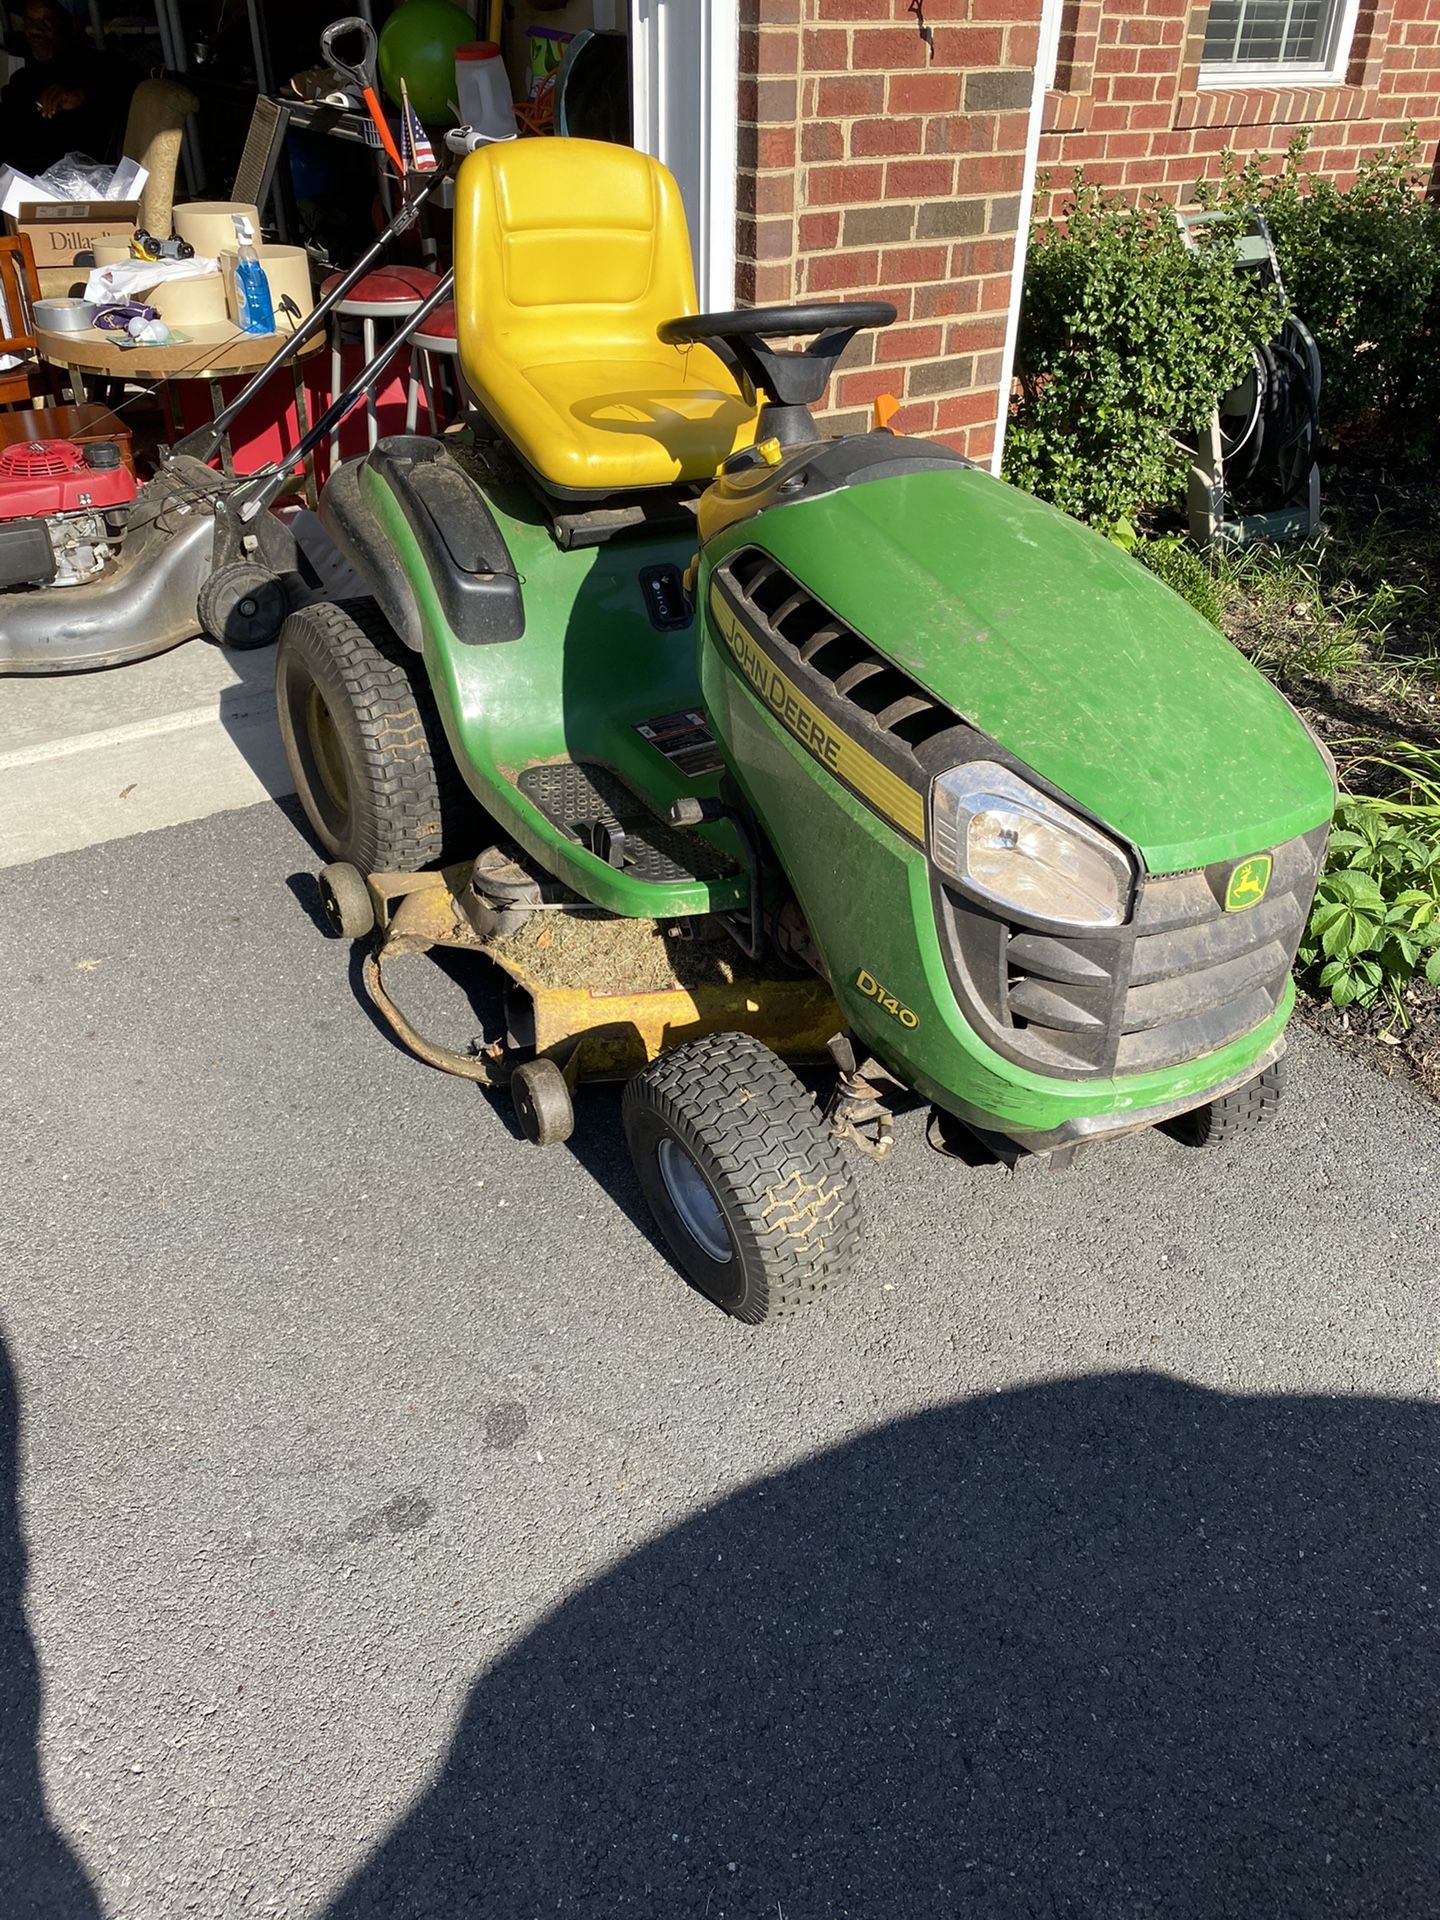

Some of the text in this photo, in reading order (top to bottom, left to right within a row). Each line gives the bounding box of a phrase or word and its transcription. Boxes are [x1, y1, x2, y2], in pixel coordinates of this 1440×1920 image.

[726, 618, 841, 769] JOHN DEERE
[855, 969, 918, 1028] D140
